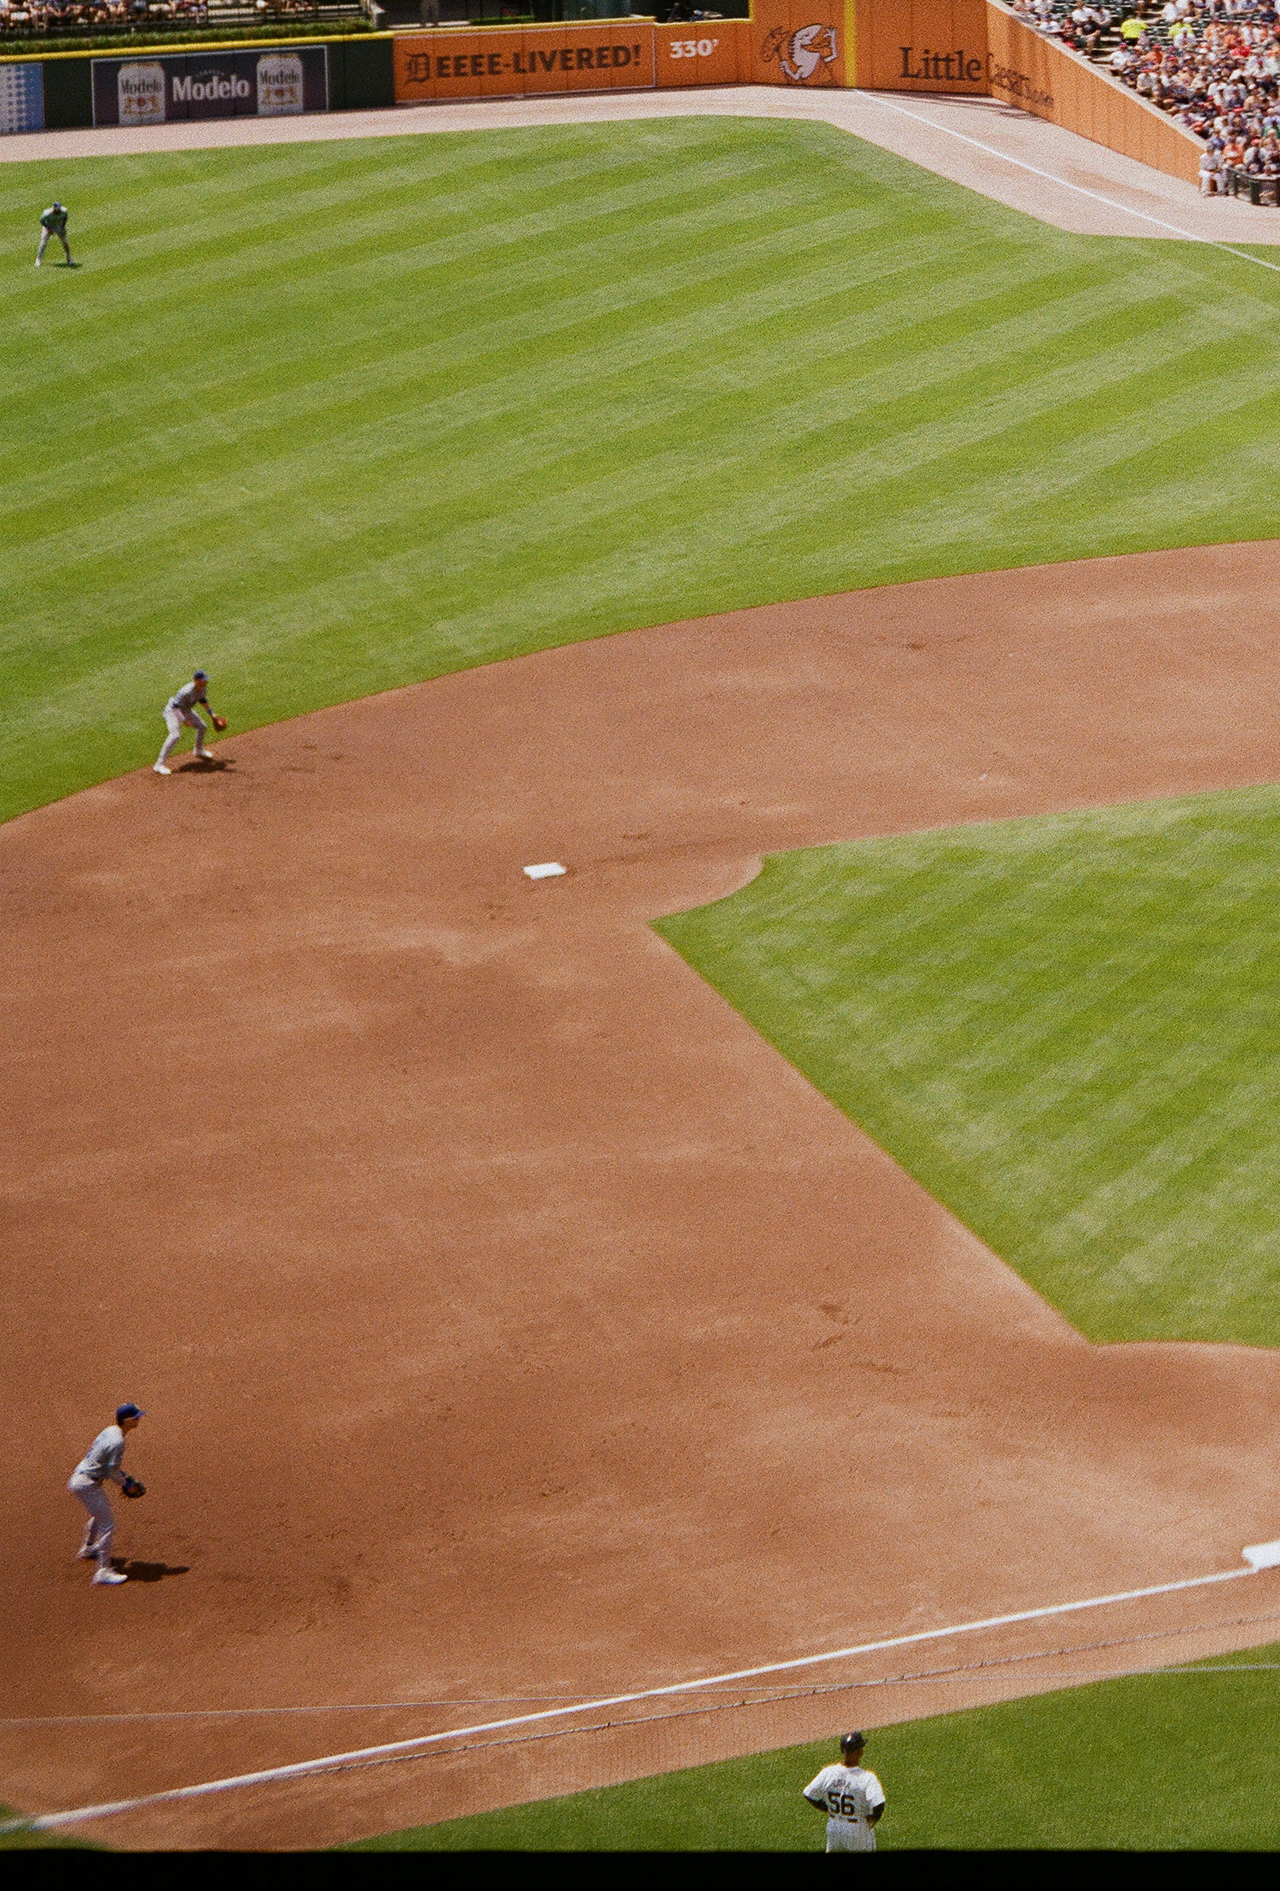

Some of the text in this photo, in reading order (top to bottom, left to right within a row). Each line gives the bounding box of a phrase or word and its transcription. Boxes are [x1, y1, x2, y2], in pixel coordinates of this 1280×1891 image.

[900, 46, 981, 82] Little
[172, 73, 250, 101] Modelo
[827, 1791, 855, 1817] 56
